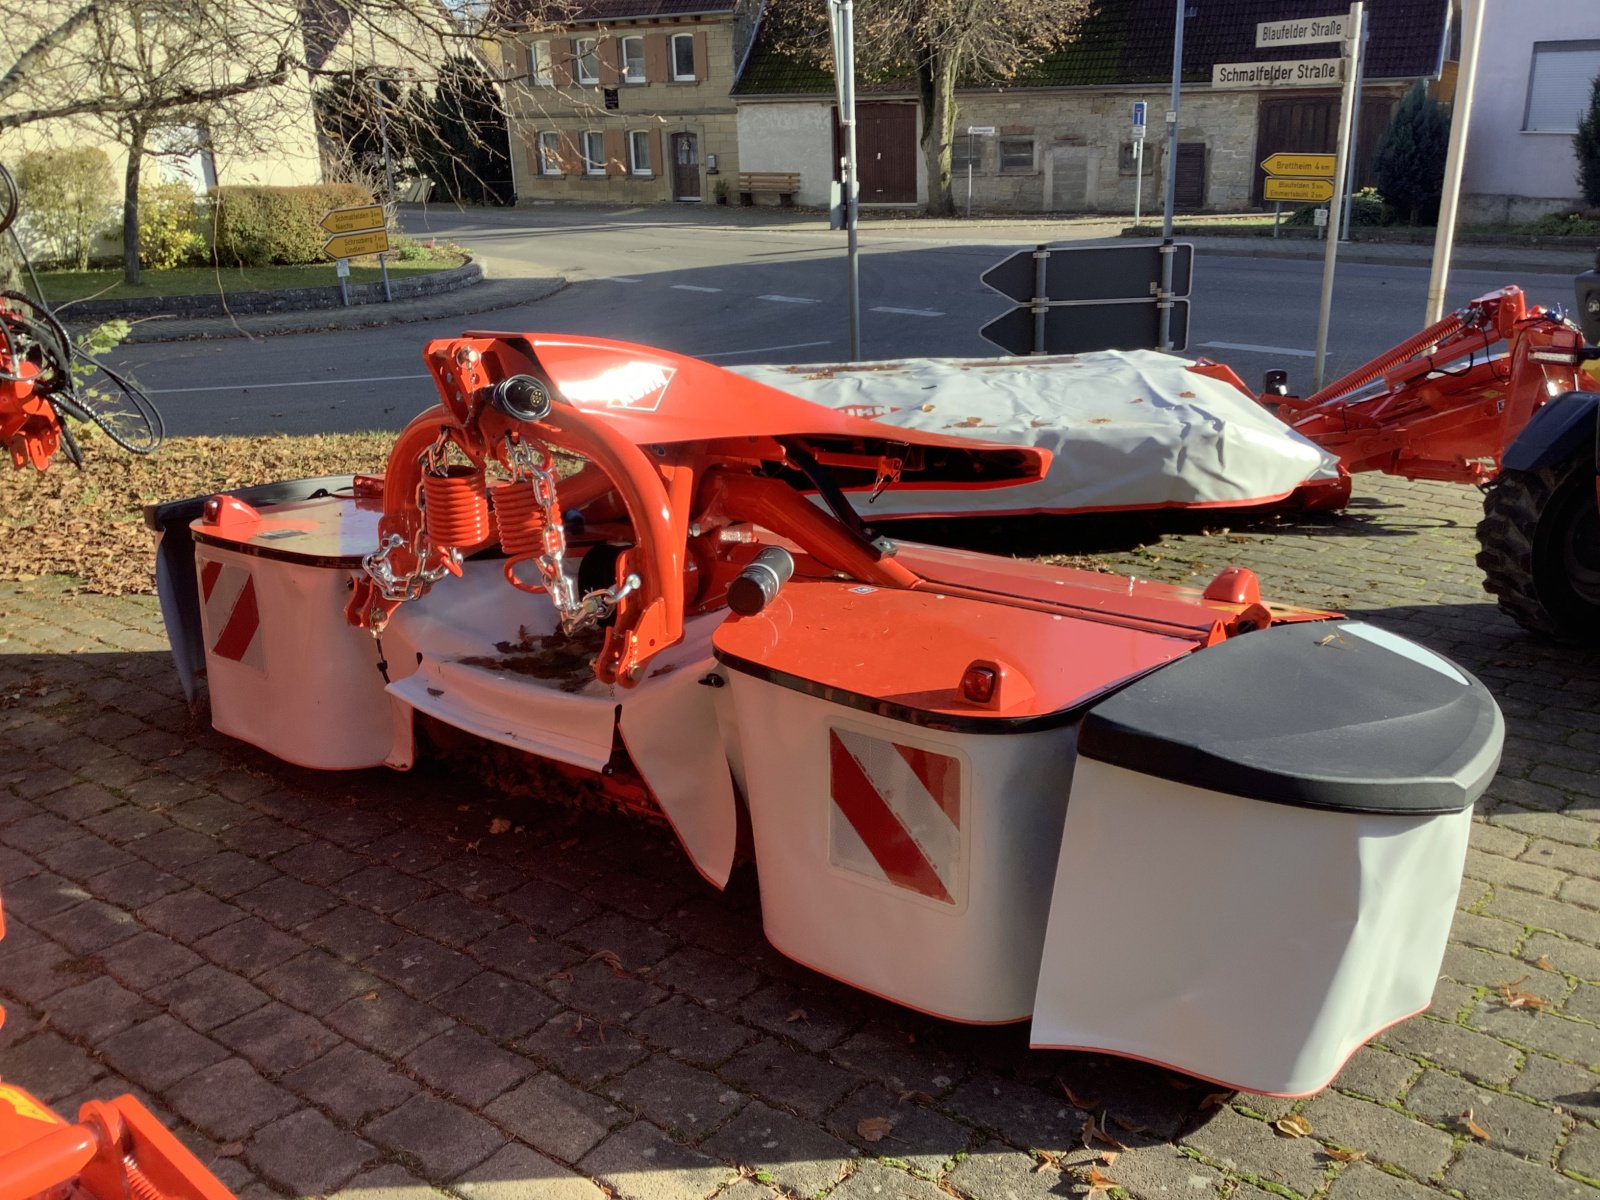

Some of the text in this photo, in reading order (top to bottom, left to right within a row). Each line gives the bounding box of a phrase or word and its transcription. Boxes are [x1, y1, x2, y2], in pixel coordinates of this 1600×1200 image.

[1263, 20, 1342, 41] Blaufelder Straße
[1219, 63, 1336, 83] Schmalfelder Straße
[1276, 161, 1312, 170] Brettheim
[1314, 161, 1320, 170] 4
